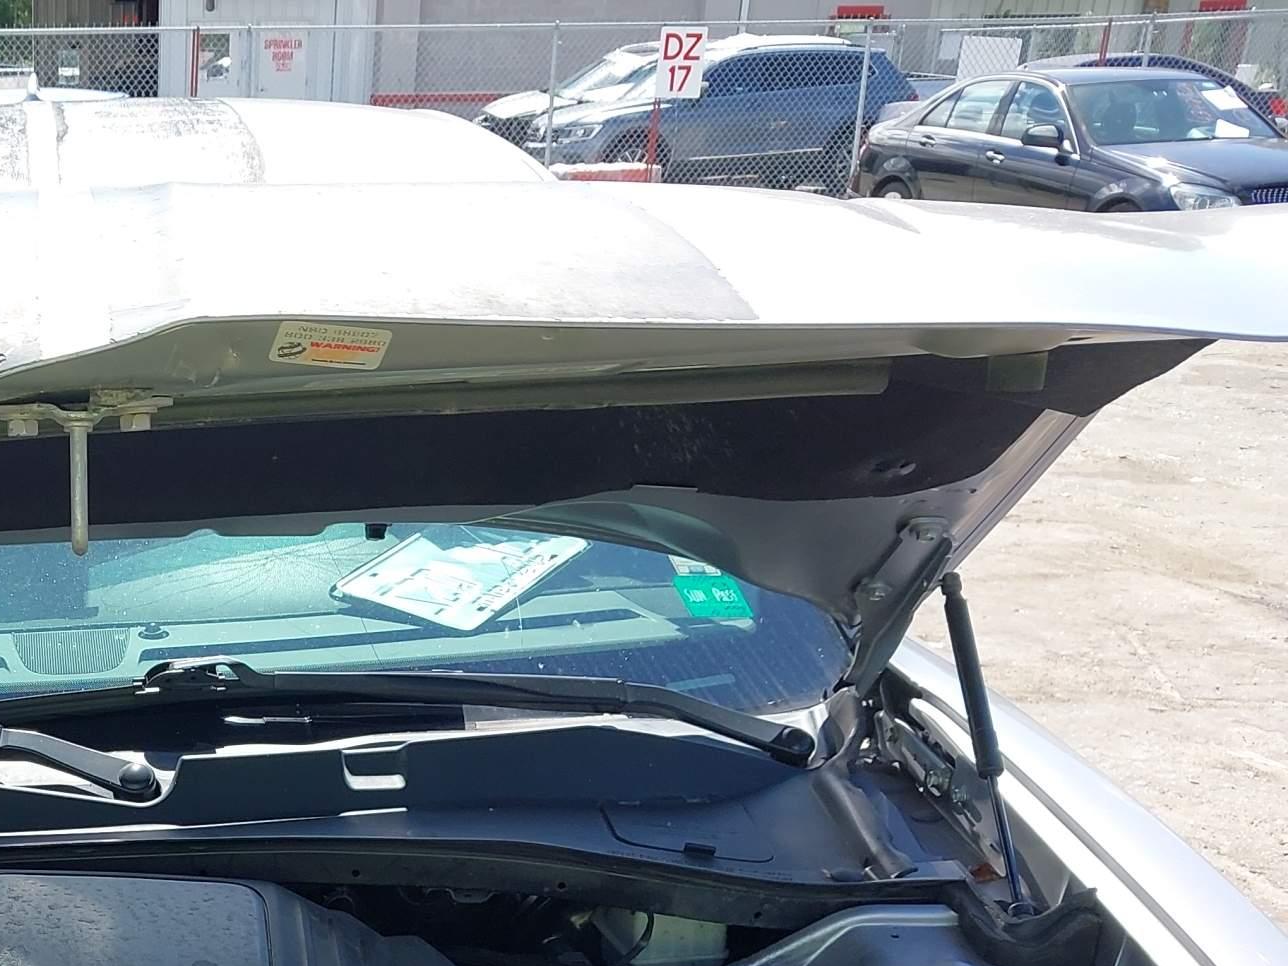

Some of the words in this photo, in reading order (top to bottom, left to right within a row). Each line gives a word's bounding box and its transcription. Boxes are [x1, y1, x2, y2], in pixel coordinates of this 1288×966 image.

[663, 32, 703, 60] DZ
[668, 65, 692, 92] 17
[310, 340, 381, 354] WARNING!
